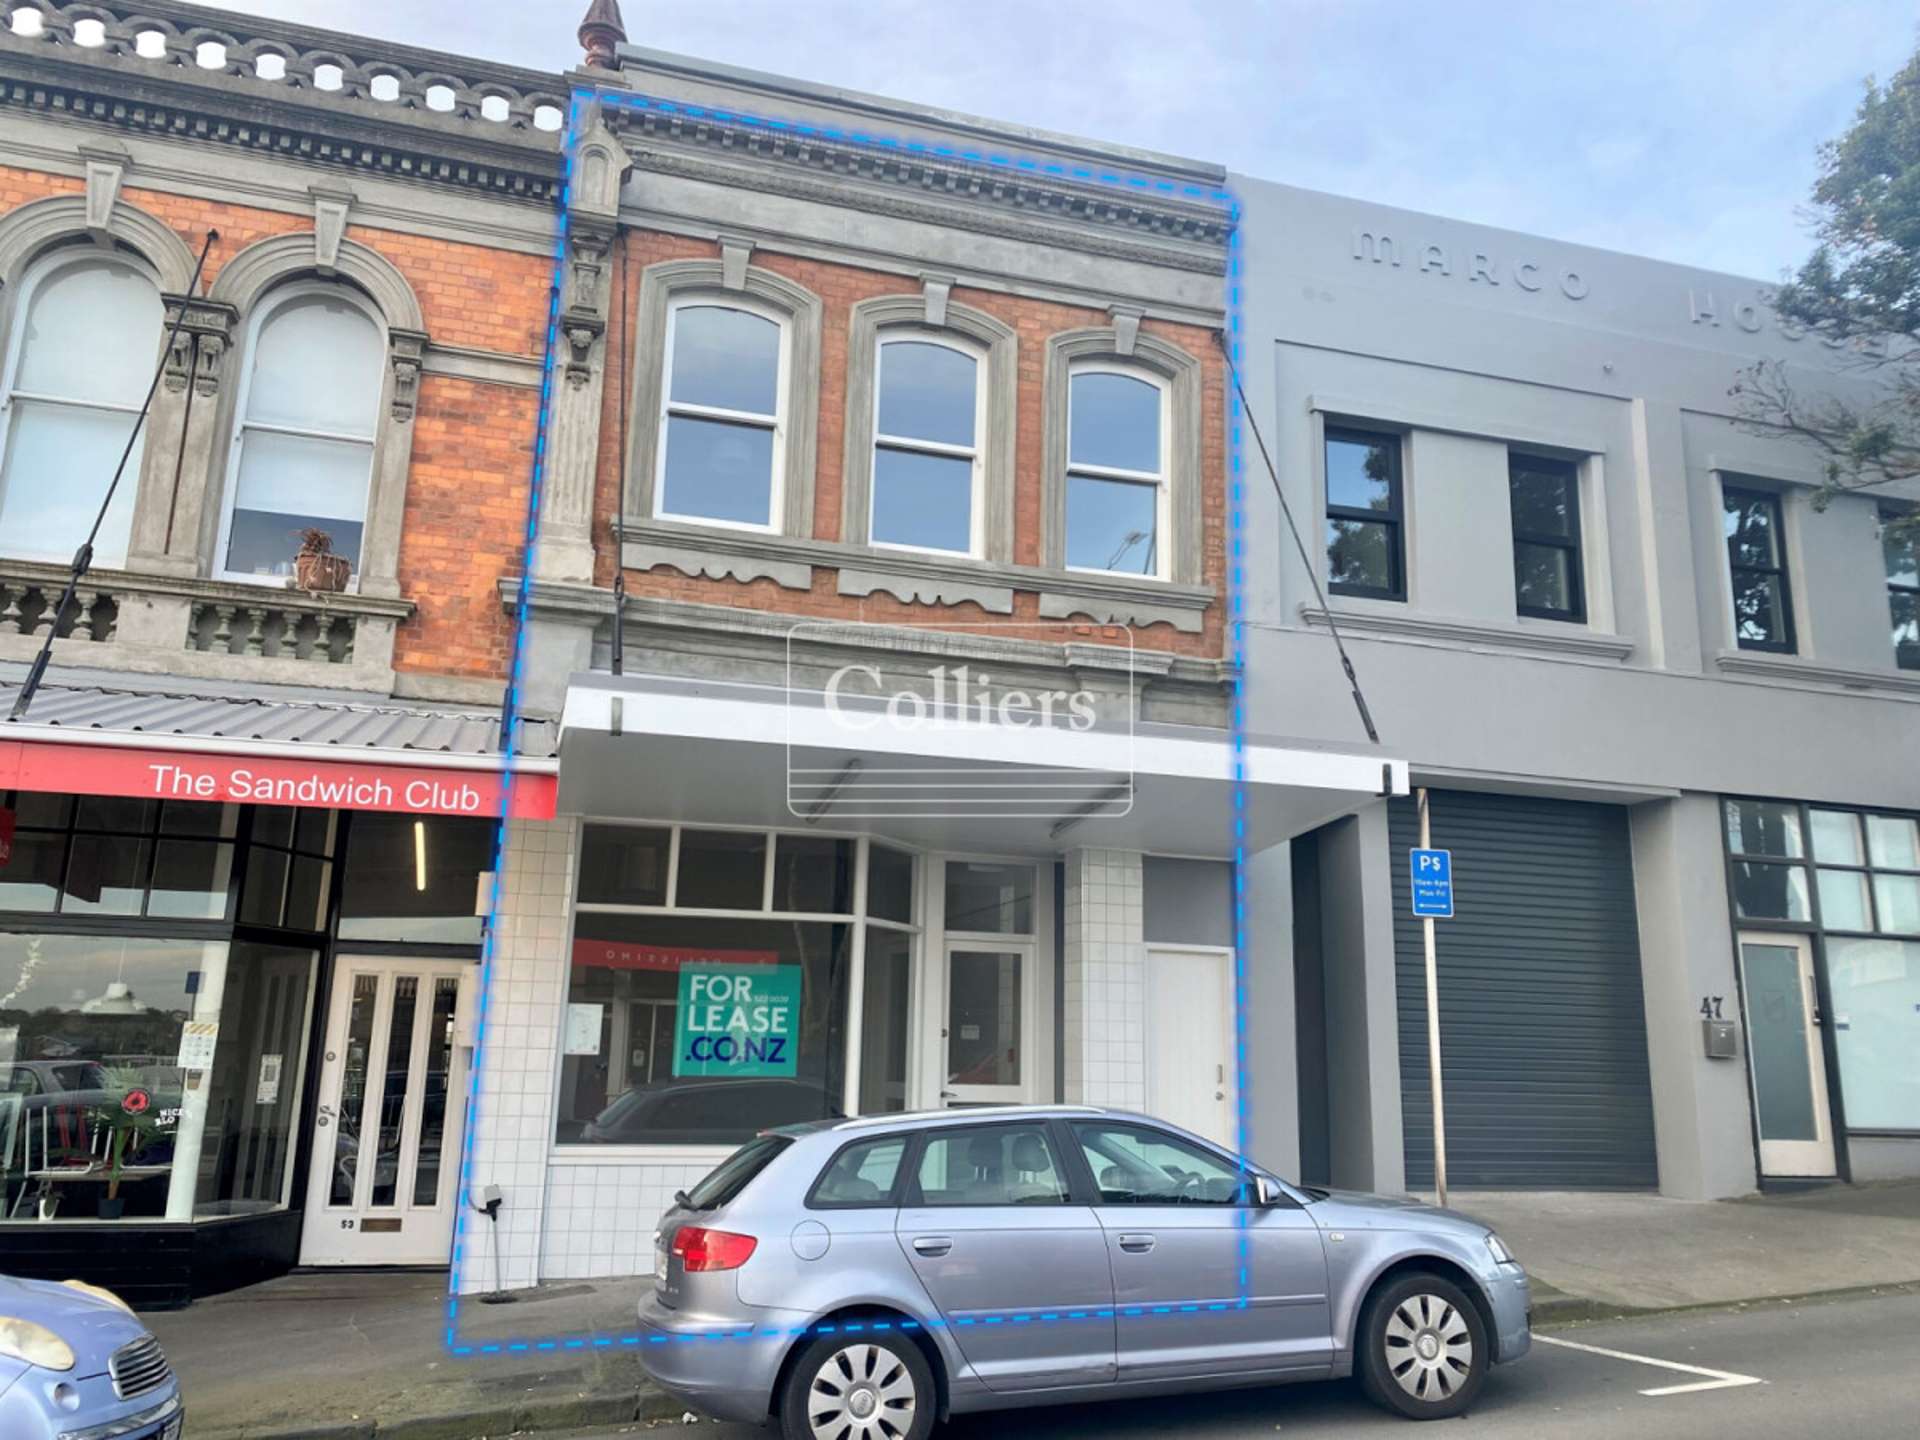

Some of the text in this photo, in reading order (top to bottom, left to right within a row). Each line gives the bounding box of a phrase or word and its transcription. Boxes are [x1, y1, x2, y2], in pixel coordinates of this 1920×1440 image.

[1351, 224, 1591, 301] MARCO
[149, 764, 480, 811] The Sandwich Club
[690, 975, 753, 1002] FOR
[687, 1005, 789, 1033] LEASE
[1700, 996, 1724, 1019] 47
